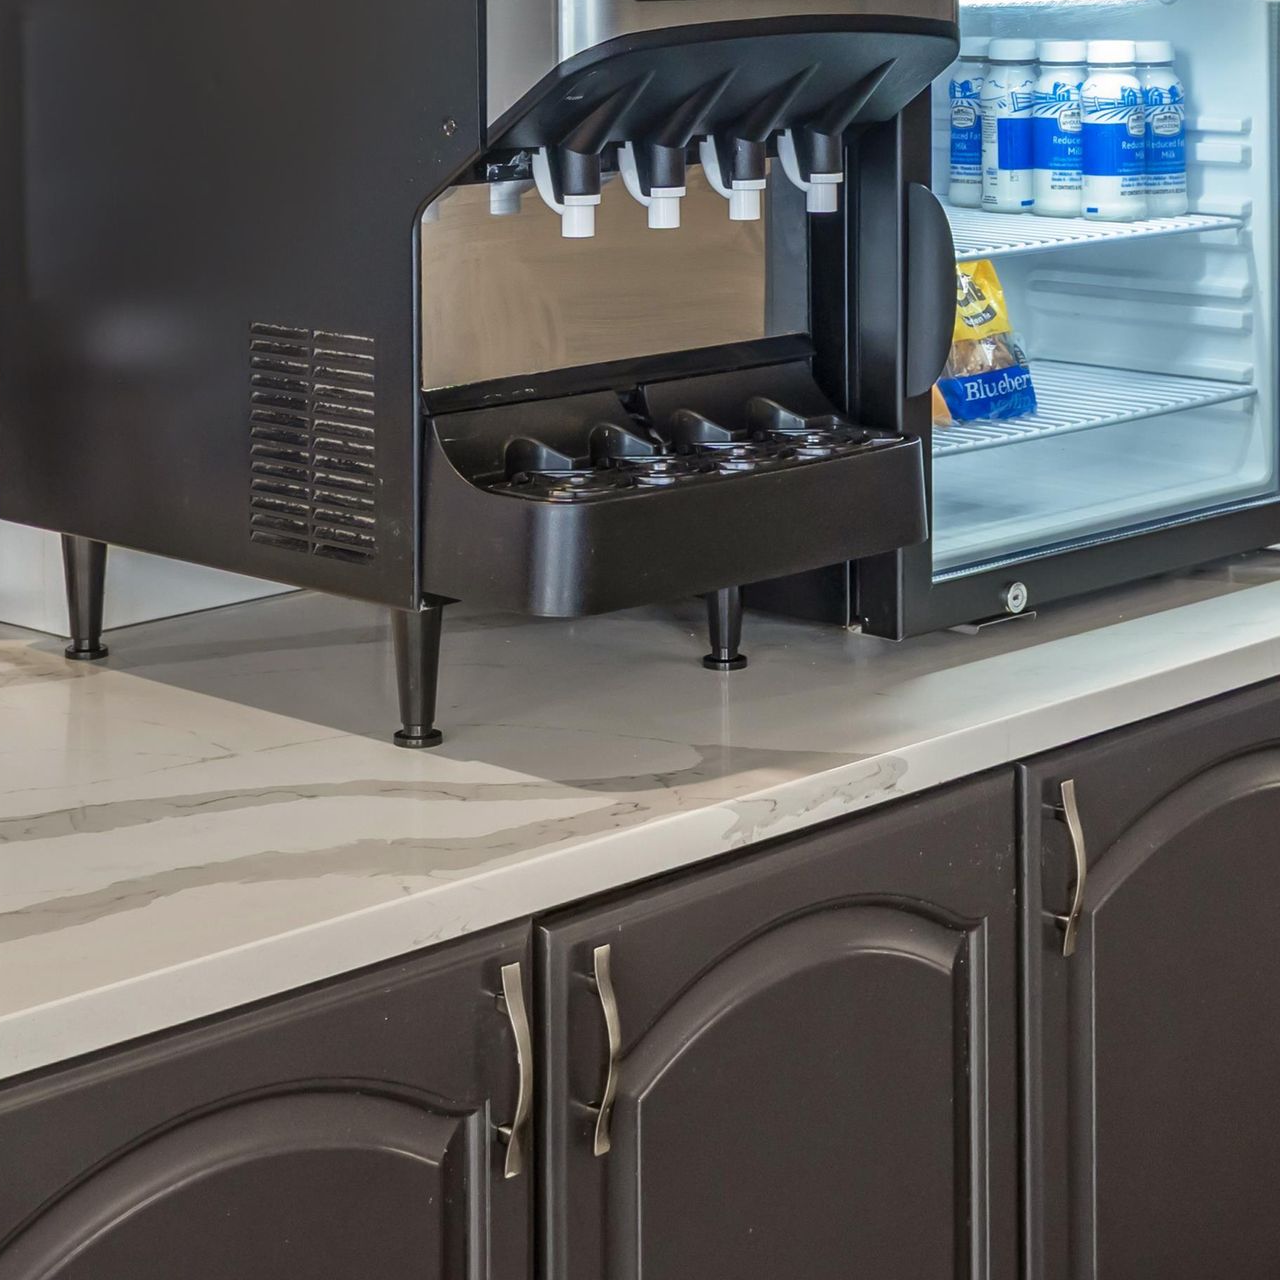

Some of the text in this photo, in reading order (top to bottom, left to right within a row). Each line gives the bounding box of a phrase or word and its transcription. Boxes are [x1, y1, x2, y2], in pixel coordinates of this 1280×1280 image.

[1052, 135, 1081, 145] Reduce
[1121, 140, 1144, 150] Reduc
[964, 372, 1034, 402] Blueber
